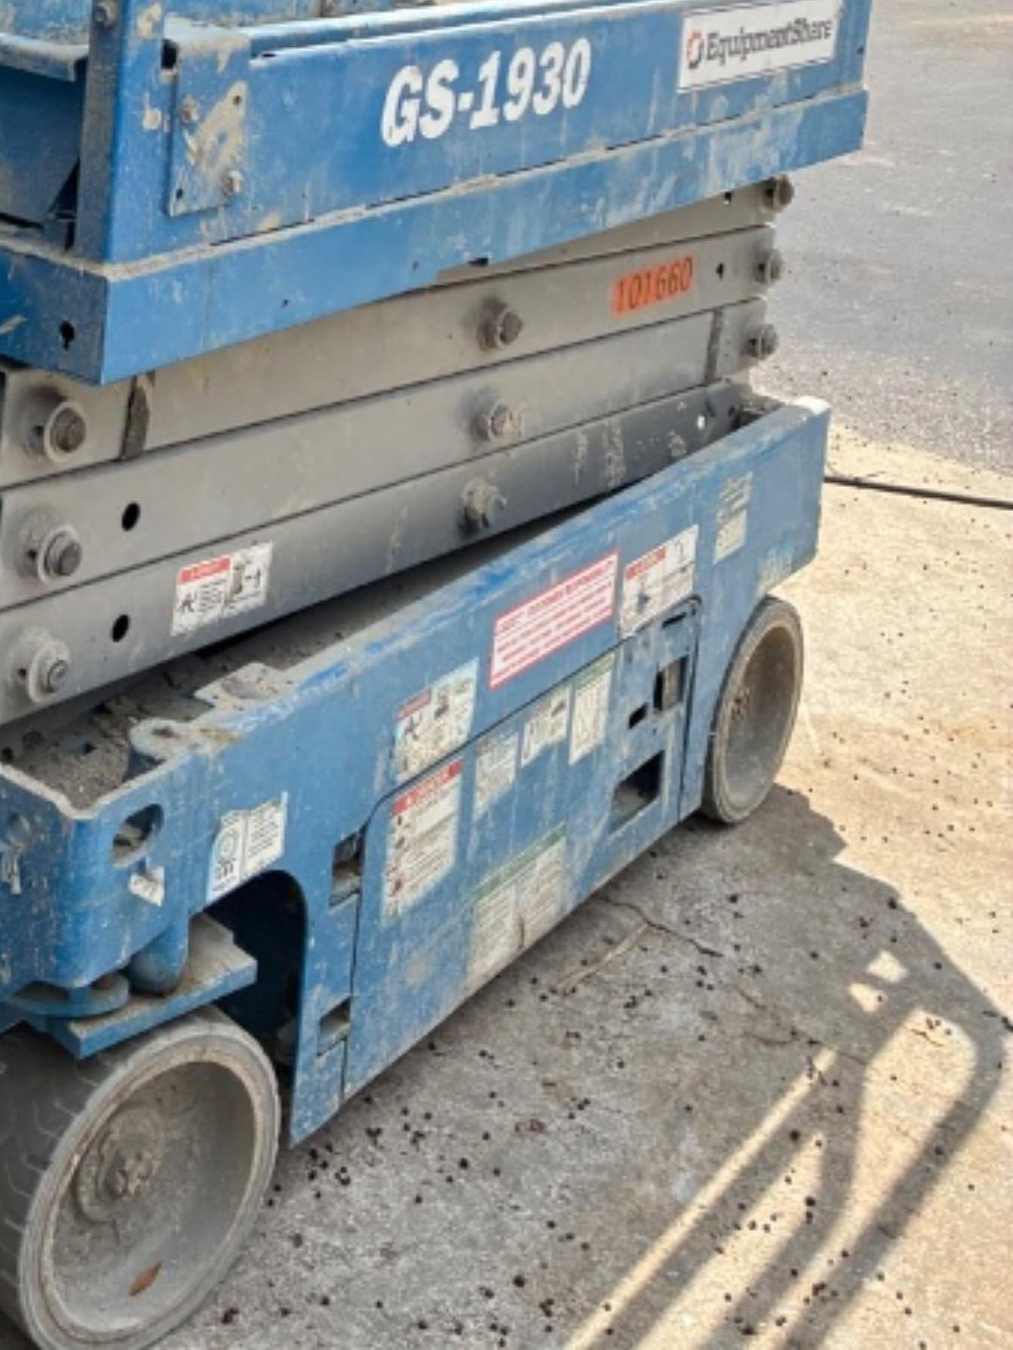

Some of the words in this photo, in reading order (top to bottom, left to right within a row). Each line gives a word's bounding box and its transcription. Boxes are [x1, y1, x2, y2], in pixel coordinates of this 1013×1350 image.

[706, 17, 833, 66] EquipmentShare
[380, 37, 592, 148] GS-1930
[616, 256, 694, 312] 101660
